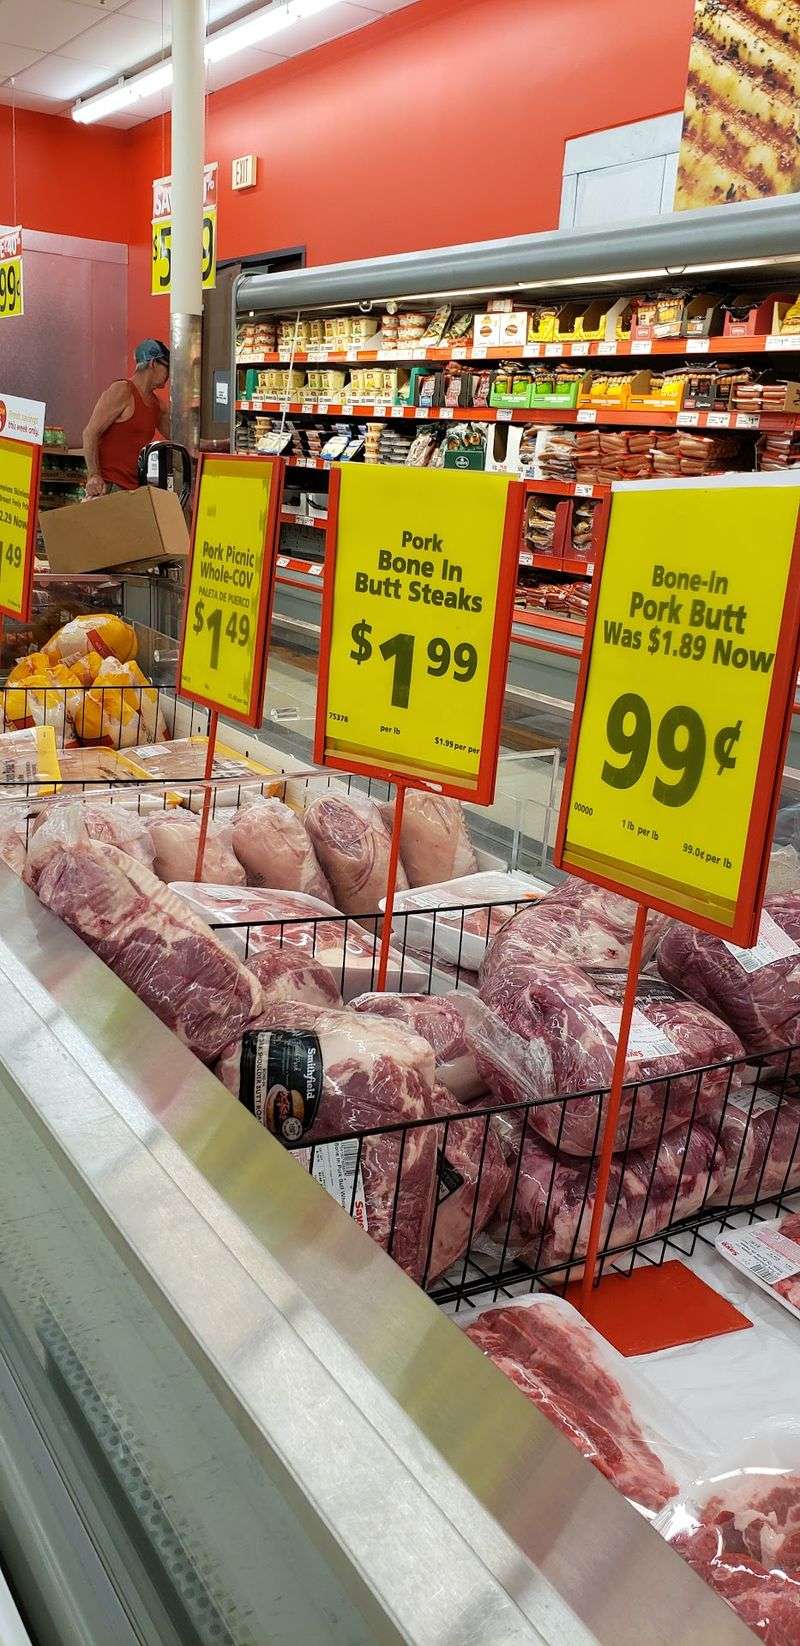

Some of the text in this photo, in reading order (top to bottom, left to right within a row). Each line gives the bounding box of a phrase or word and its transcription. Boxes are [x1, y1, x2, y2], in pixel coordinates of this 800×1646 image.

[203, 541, 255, 568] Pork Picnic
[402, 530, 443, 552] Pork
[200, 561, 254, 589] Whole-COV
[378, 550, 463, 583] Bone In
[652, 564, 728, 595] Bone-In
[355, 572, 483, 613] Butt Steaks
[629, 592, 748, 635] Pork Butt
[604, 620, 775, 673] Was $1.89 Now
[380, 725, 391, 734] per
[637, 826, 650, 838] per
[651, 831, 660, 841] lb
[705, 853, 721, 865] per
[723, 857, 733, 869] lb
[304, 1047, 317, 1100] Smithfield
